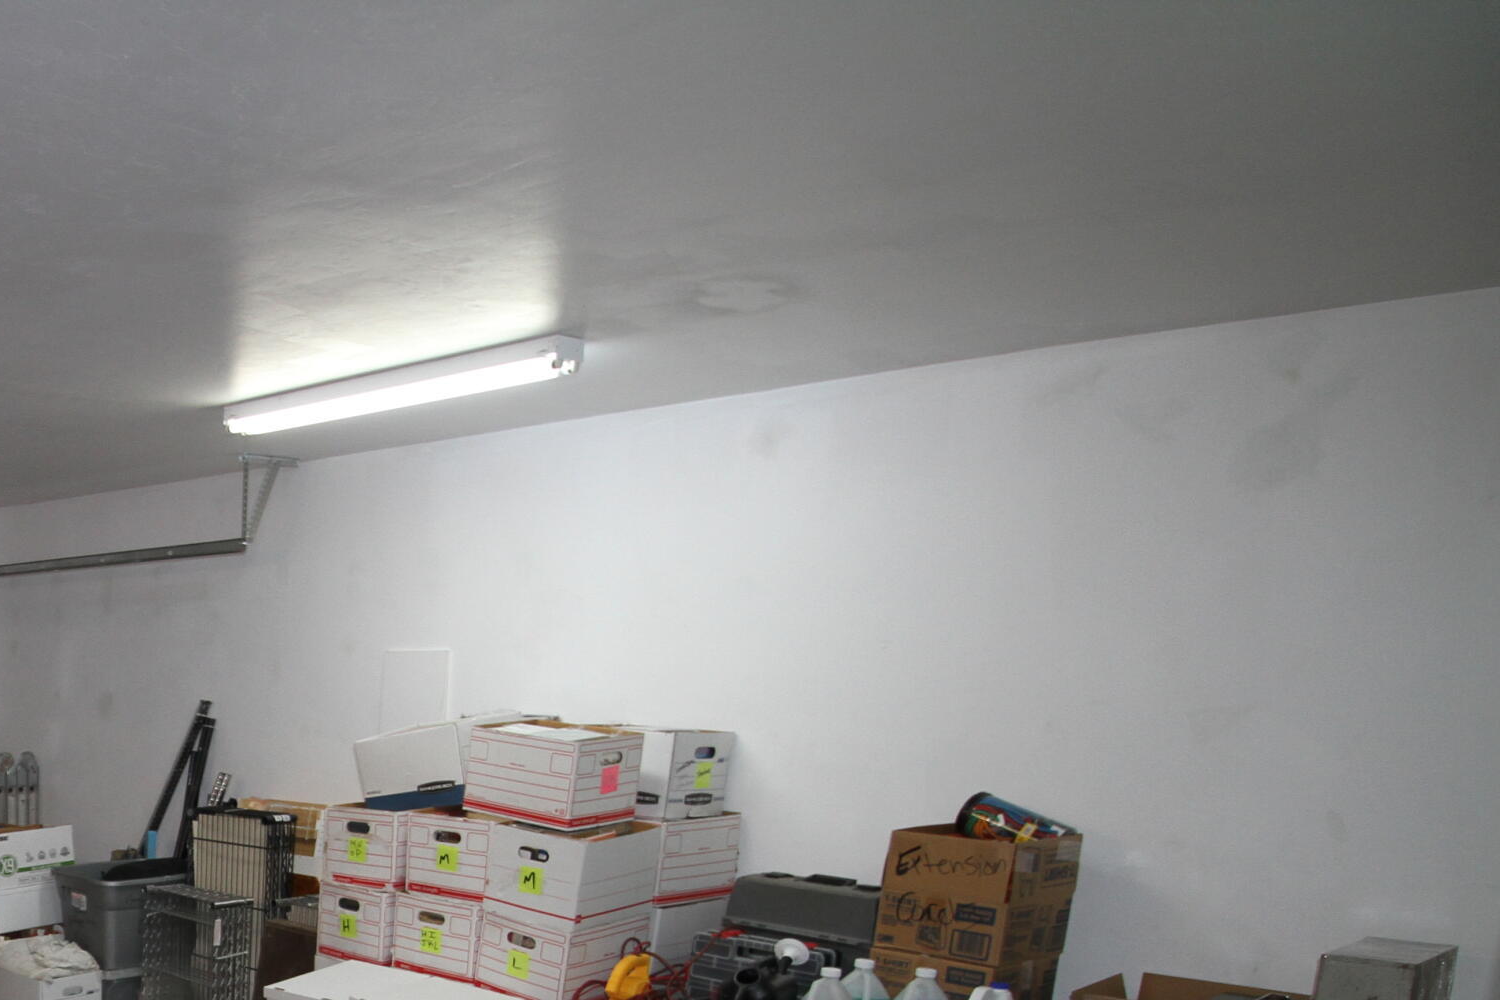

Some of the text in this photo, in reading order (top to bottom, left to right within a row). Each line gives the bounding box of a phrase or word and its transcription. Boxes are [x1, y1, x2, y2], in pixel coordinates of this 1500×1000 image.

[439, 854, 450, 865] M
[895, 846, 1007, 876] Extension
[523, 871, 536, 890] M
[342, 918, 351, 932] H
[512, 957, 522, 970] L
